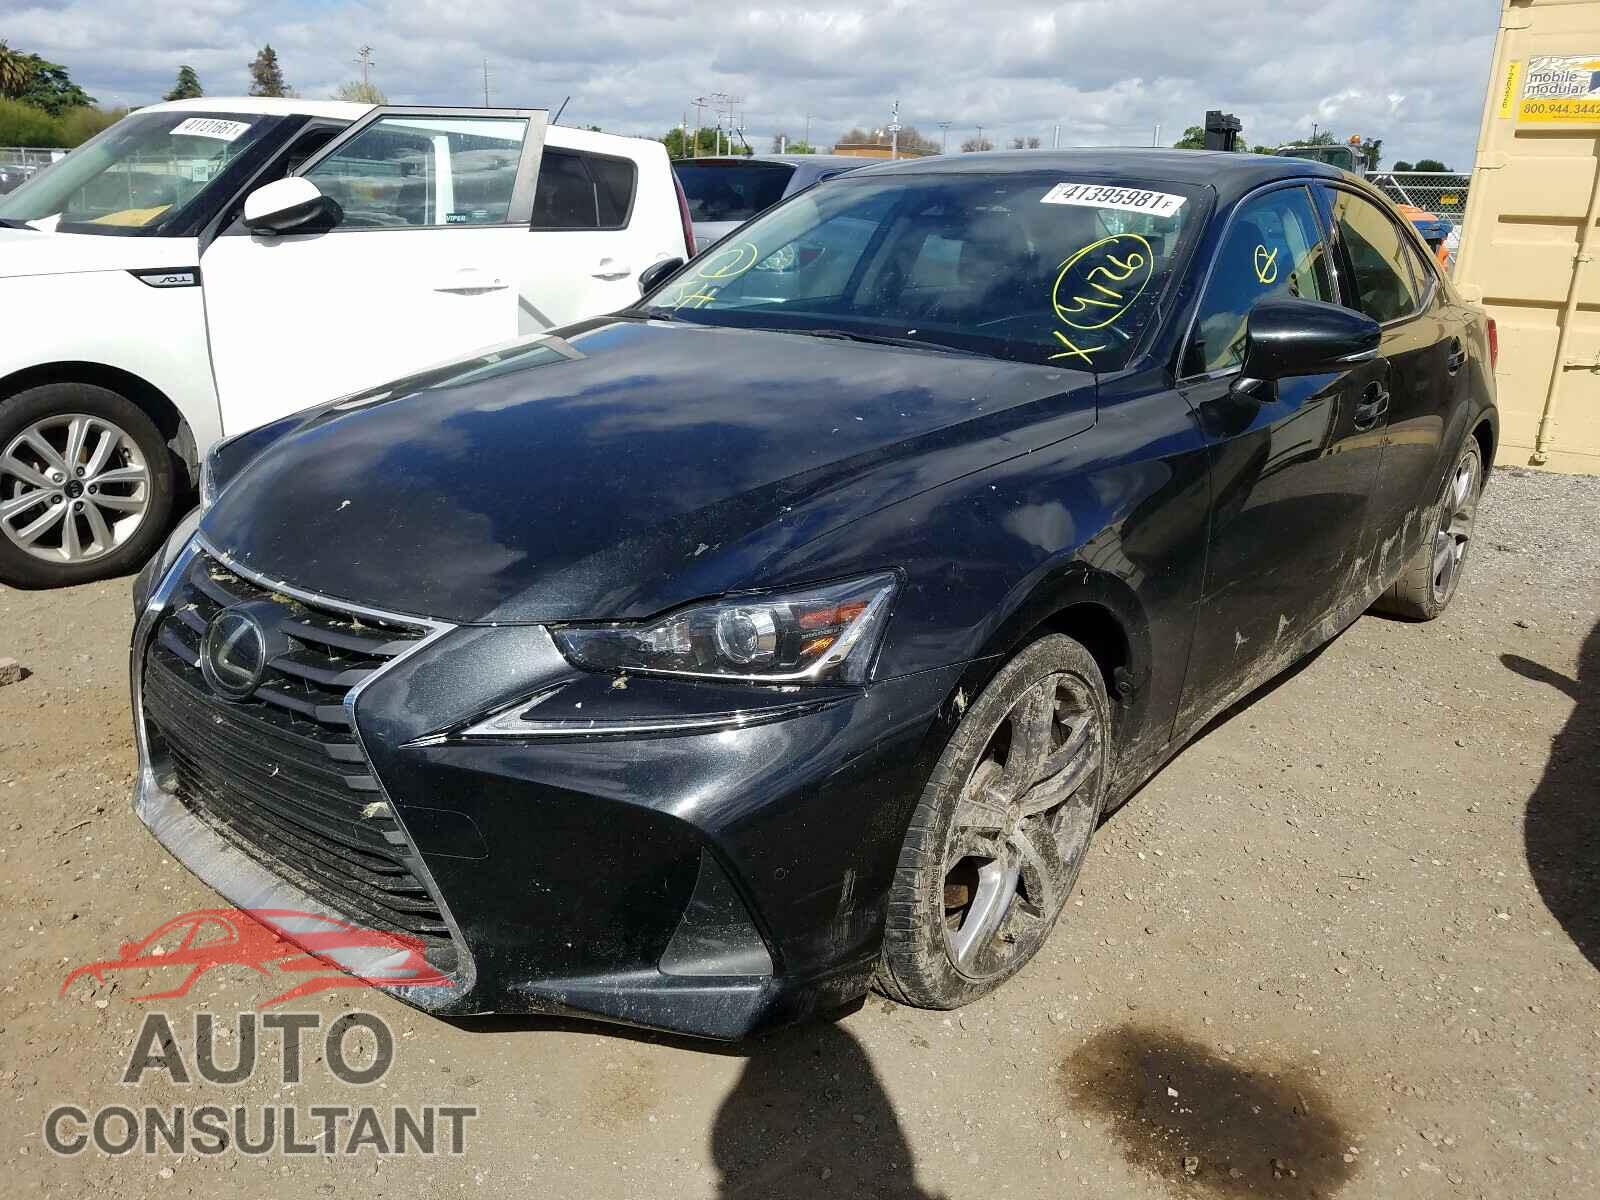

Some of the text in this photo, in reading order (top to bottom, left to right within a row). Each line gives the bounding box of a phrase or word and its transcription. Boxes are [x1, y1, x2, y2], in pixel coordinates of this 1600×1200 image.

[1529, 71, 1577, 82] mobile
[1527, 83, 1586, 94] modular
[1063, 185, 1166, 209] 41395981
